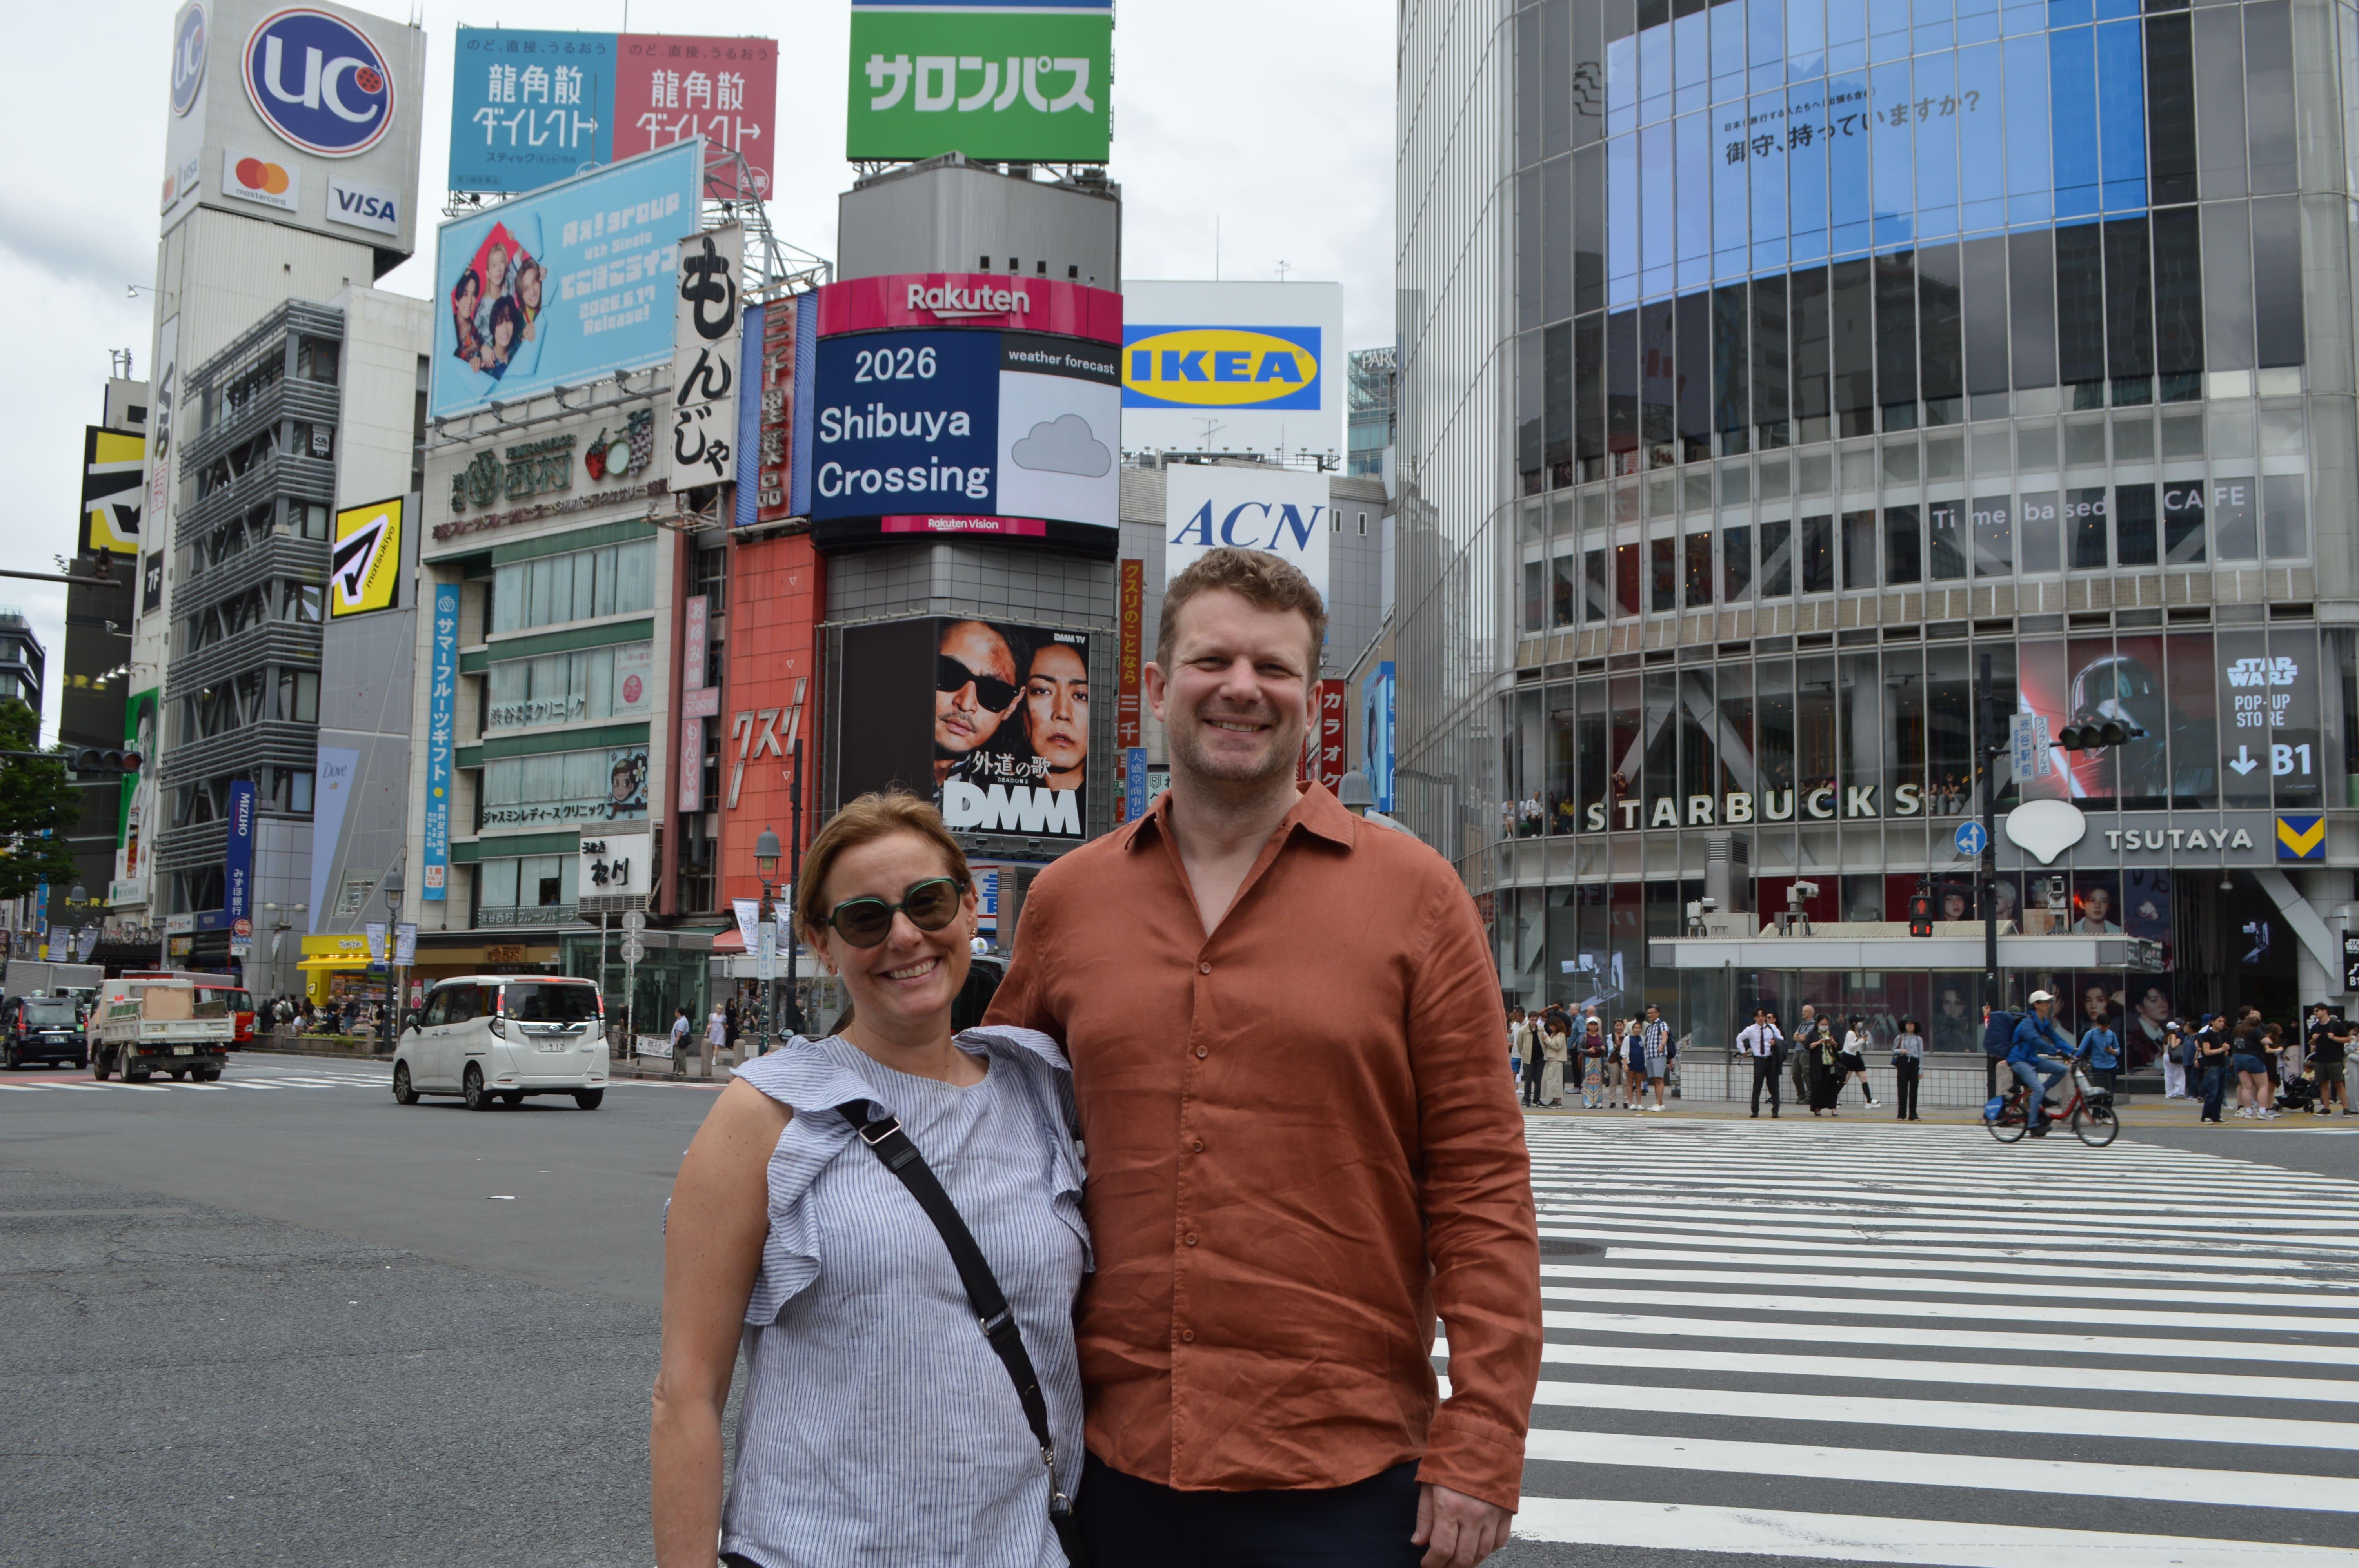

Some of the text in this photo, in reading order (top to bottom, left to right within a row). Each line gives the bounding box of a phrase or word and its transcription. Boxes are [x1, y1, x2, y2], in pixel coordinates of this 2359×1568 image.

[467, 39, 606, 54] のど、直接、うるおう
[629, 44, 768, 60] のど、直接、うるおう
[488, 64, 583, 105] 龍角散
[652, 69, 745, 110] 龍角散
[865, 54, 1094, 113] サロンパス
[486, 152, 535, 163] スティック
[236, 188, 286, 206] mastercard
[332, 187, 396, 223] VISA
[607, 192, 680, 234] group
[611, 232, 652, 254] Single
[907, 282, 1030, 313] Rakuten
[583, 303, 650, 336] Release!
[674, 236, 736, 477] もんじゃ
[855, 347, 936, 383] 2026
[1009, 350, 1115, 375] weather forecast
[1131, 350, 1303, 383] IKEA
[756, 304, 789, 508] 三千里薬品
[820, 402, 970, 443] Shibuya
[818, 456, 990, 499] Crossing
[928, 518, 999, 530] Rakuten Vision
[1169, 499, 1326, 552] ACN
[365, 525, 395, 588] matsukiyo
[148, 567, 160, 593] 7F
[1054, 633, 1085, 644] DMM TV
[1123, 564, 1139, 684] クスリのことなら
[688, 602, 703, 684] お好み焼
[2227, 657, 2297, 672] STAR
[2227, 671, 2297, 687] WARS
[432, 618, 454, 782] サマーフルーツギフト
[2235, 694, 2290, 711] POP-UP
[1322, 693, 1341, 788] カラオケ
[2020, 719, 2032, 777] 渋谷駅前
[322, 762, 348, 779] Dove
[972, 750, 1053, 780] 外道の歌
[2272, 743, 2311, 776] B1
[238, 792, 250, 837] MIZUHO
[943, 780, 1081, 835] DMM
[1587, 784, 1919, 831] STARBUCKS
[2105, 828, 2254, 851] TSUTAYA
[591, 858, 630, 887] 松川
[231, 868, 244, 916] みずほ銀行
